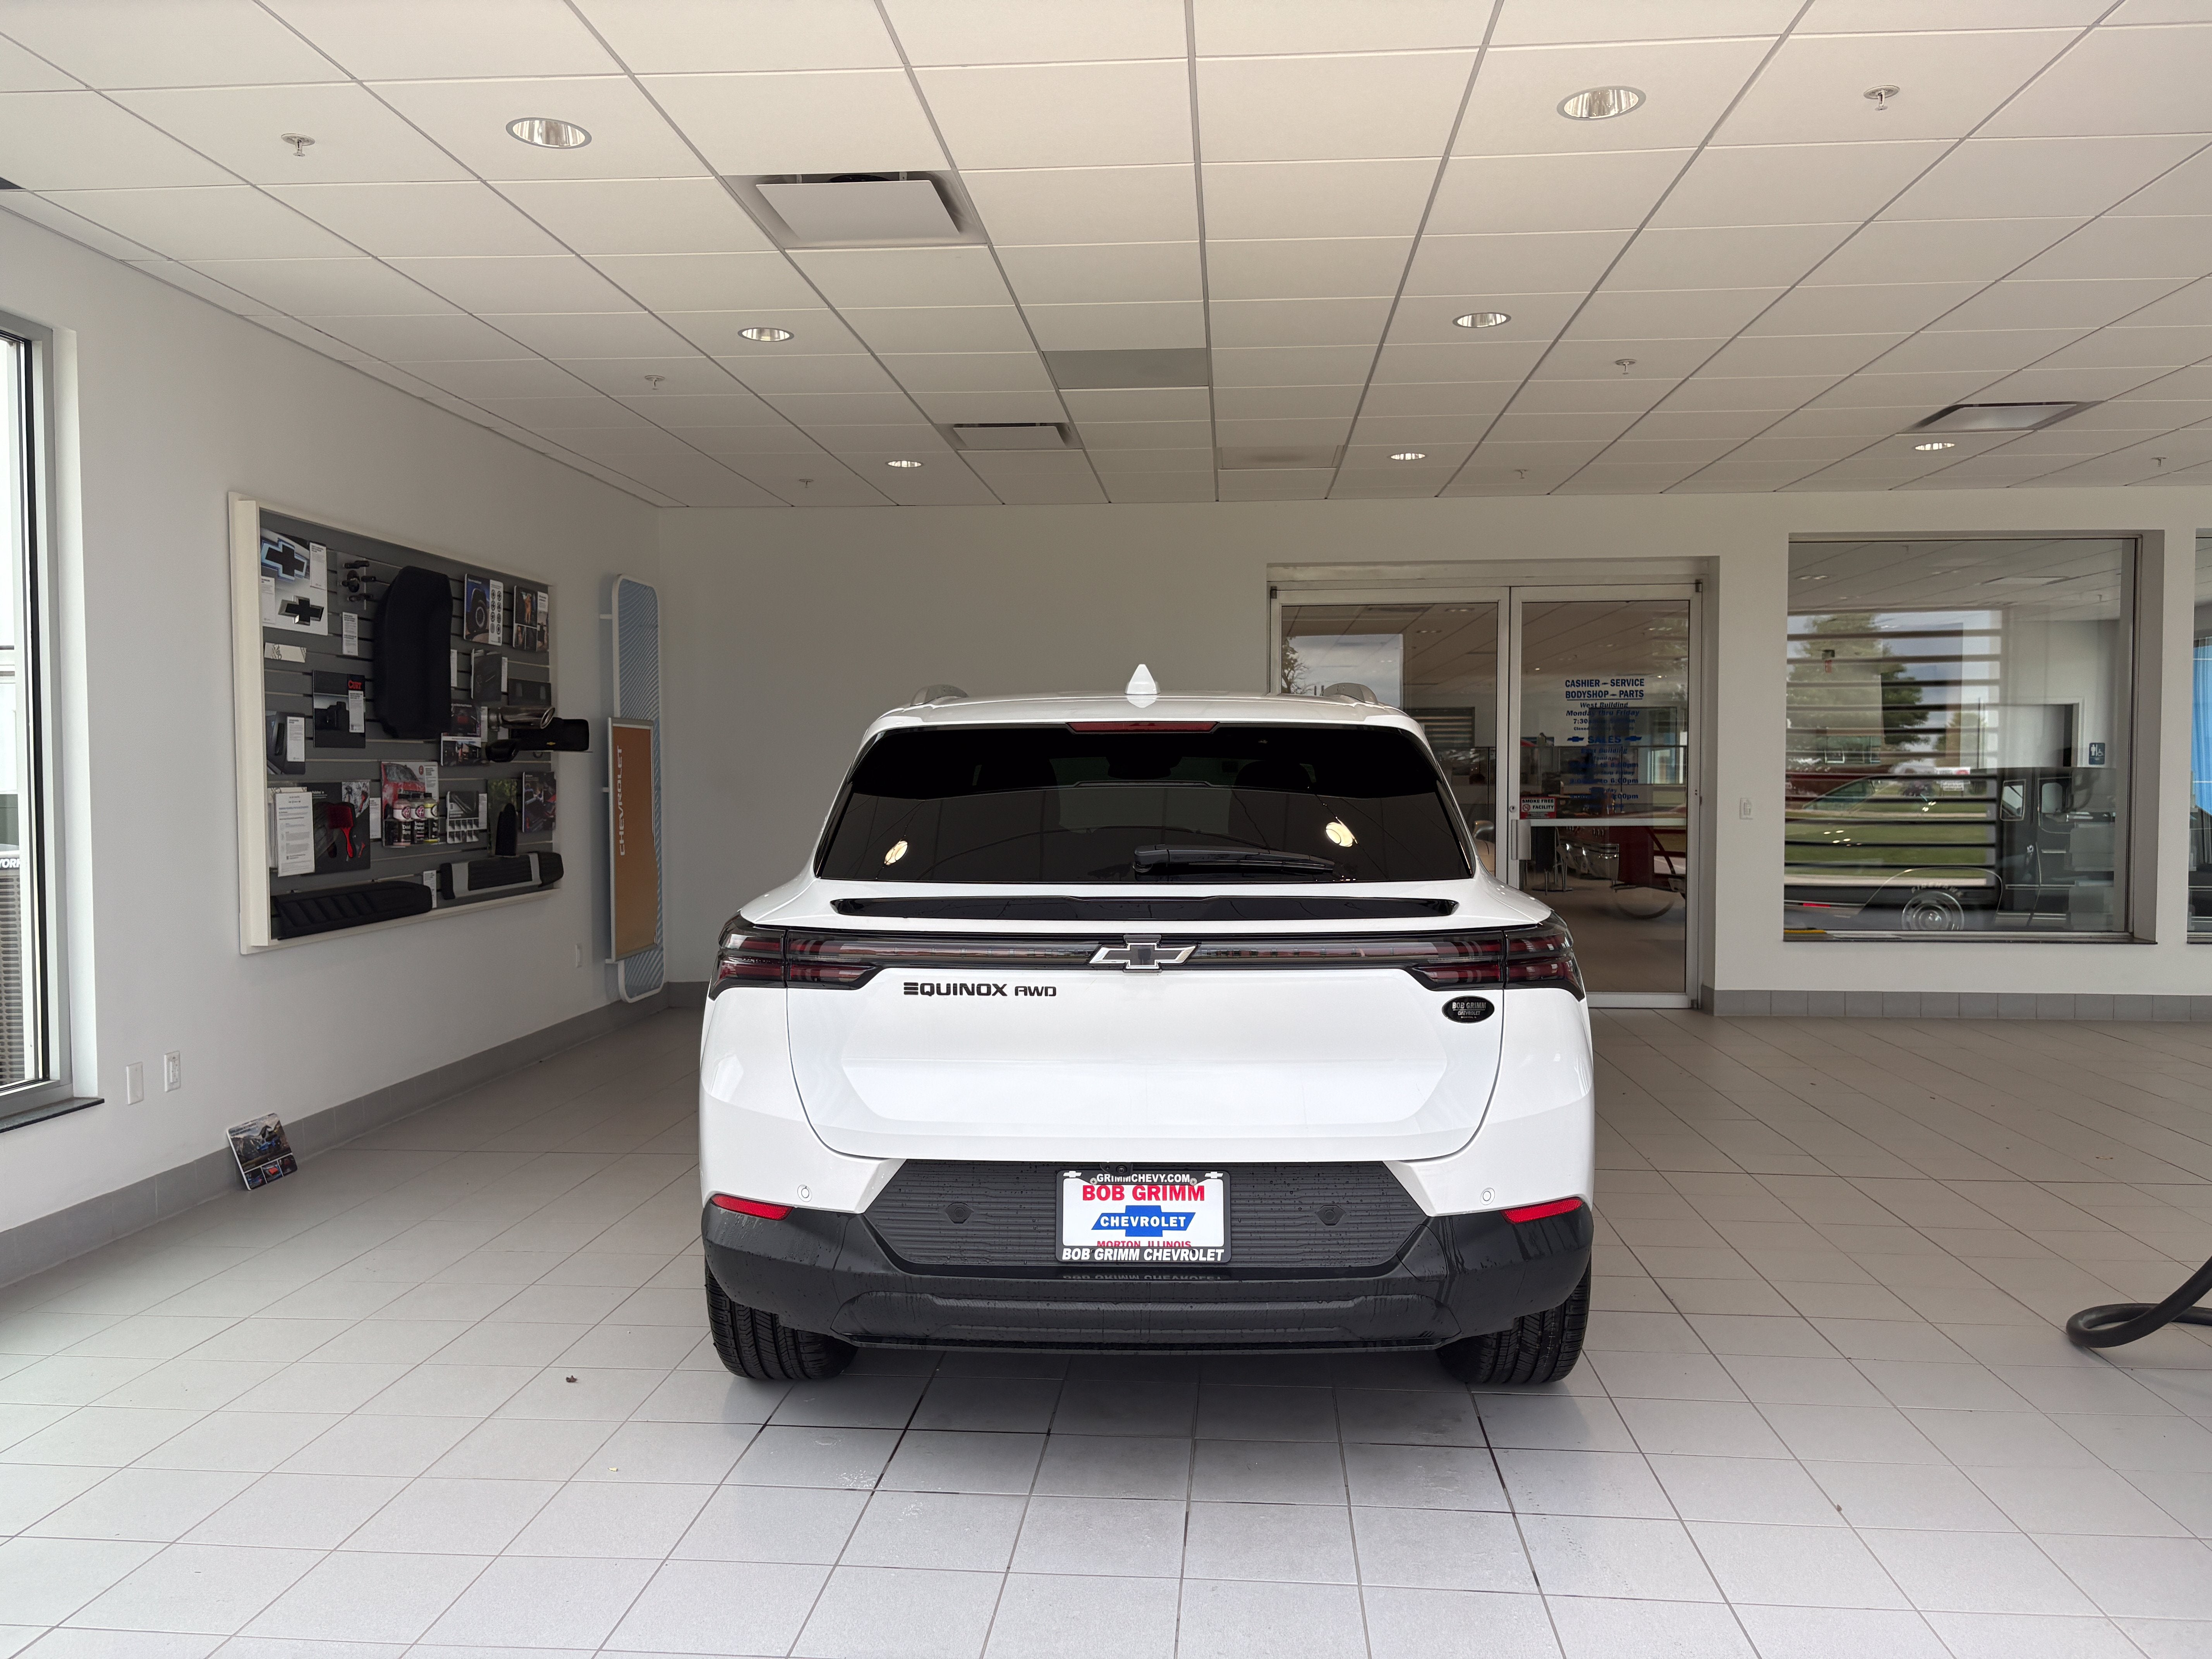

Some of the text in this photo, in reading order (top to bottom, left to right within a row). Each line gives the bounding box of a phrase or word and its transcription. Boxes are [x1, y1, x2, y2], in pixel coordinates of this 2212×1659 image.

[1565, 679, 1600, 687] CASHIER
[1566, 690, 1609, 698] BODYSHOP
[903, 982, 1056, 996] EQUINOX AWD
[1096, 1173, 1190, 1183] GRIMMCHEVY.COM
[1082, 1185, 1204, 1201] BOB GRIMM
[1100, 1216, 1186, 1227] CHEVROLET
[1062, 1248, 1224, 1261] BOB GRIMM CHEVROLET
